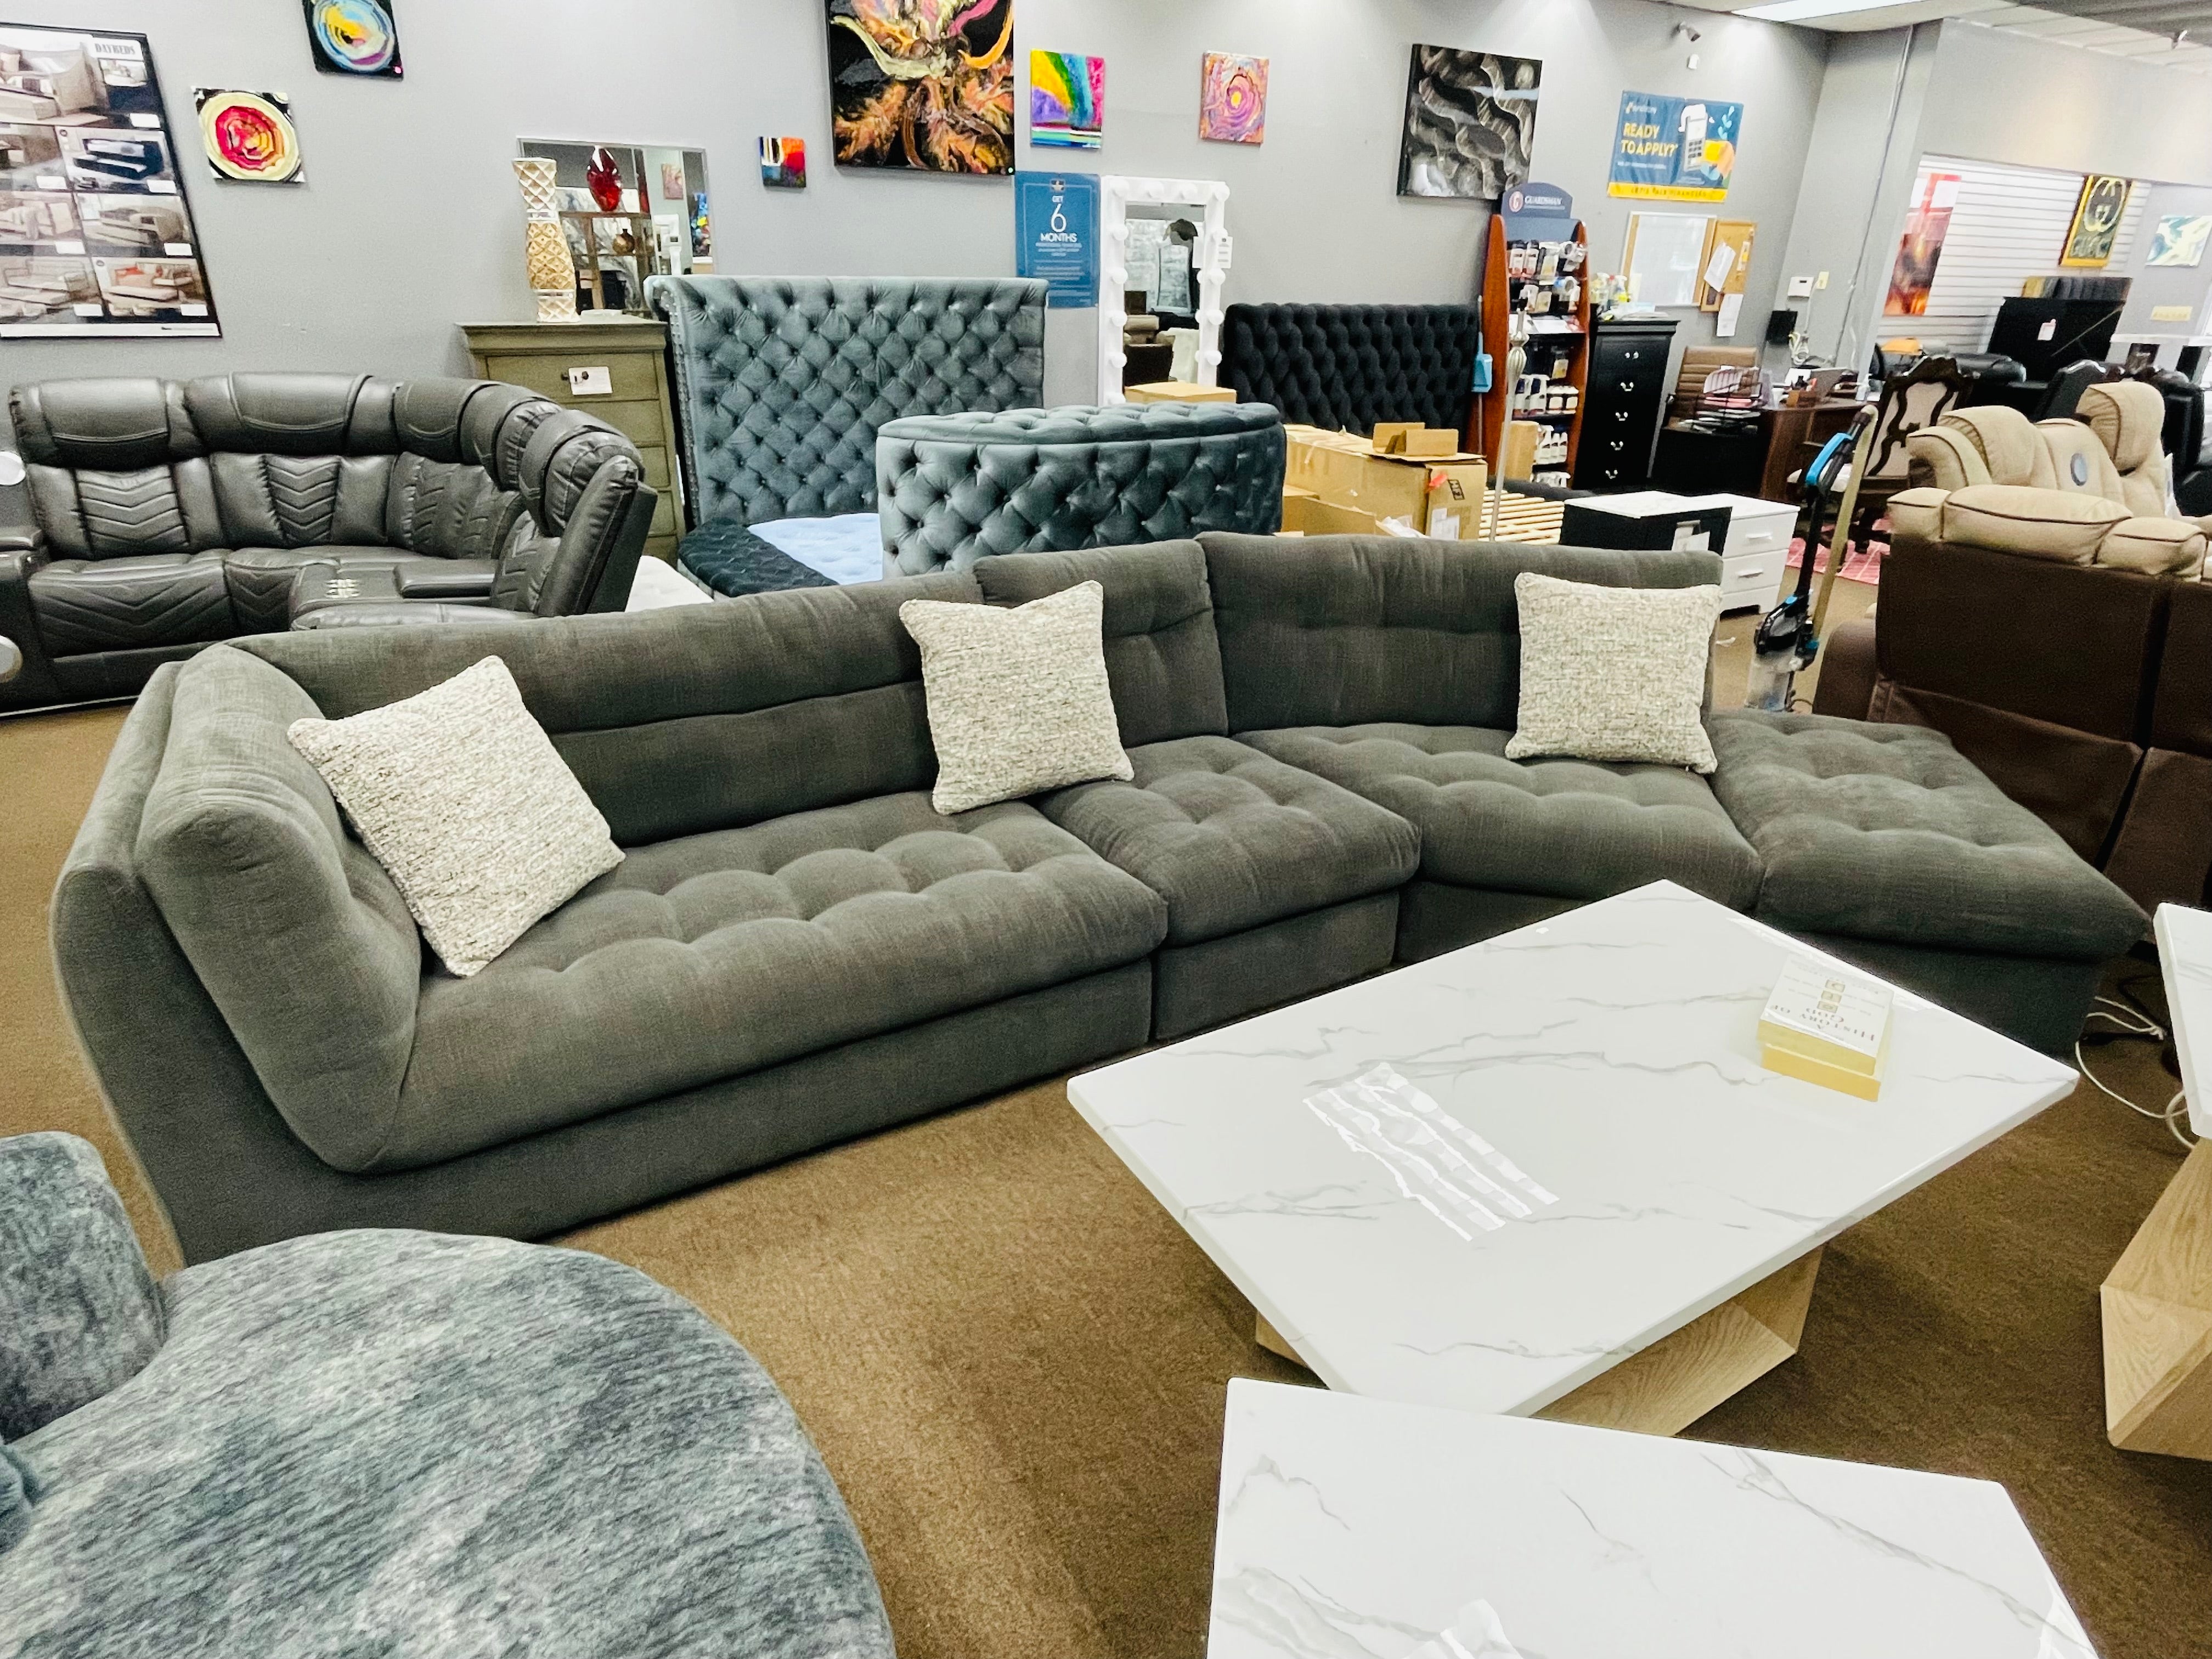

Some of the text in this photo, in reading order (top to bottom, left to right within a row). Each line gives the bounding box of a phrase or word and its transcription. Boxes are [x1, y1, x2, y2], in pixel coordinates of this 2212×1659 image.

[1623, 122, 1660, 139] READY
[1621, 139, 1678, 157] TO APPLY?
[1051, 203, 1066, 233] 6
[1040, 233, 1077, 242] MONTHS
